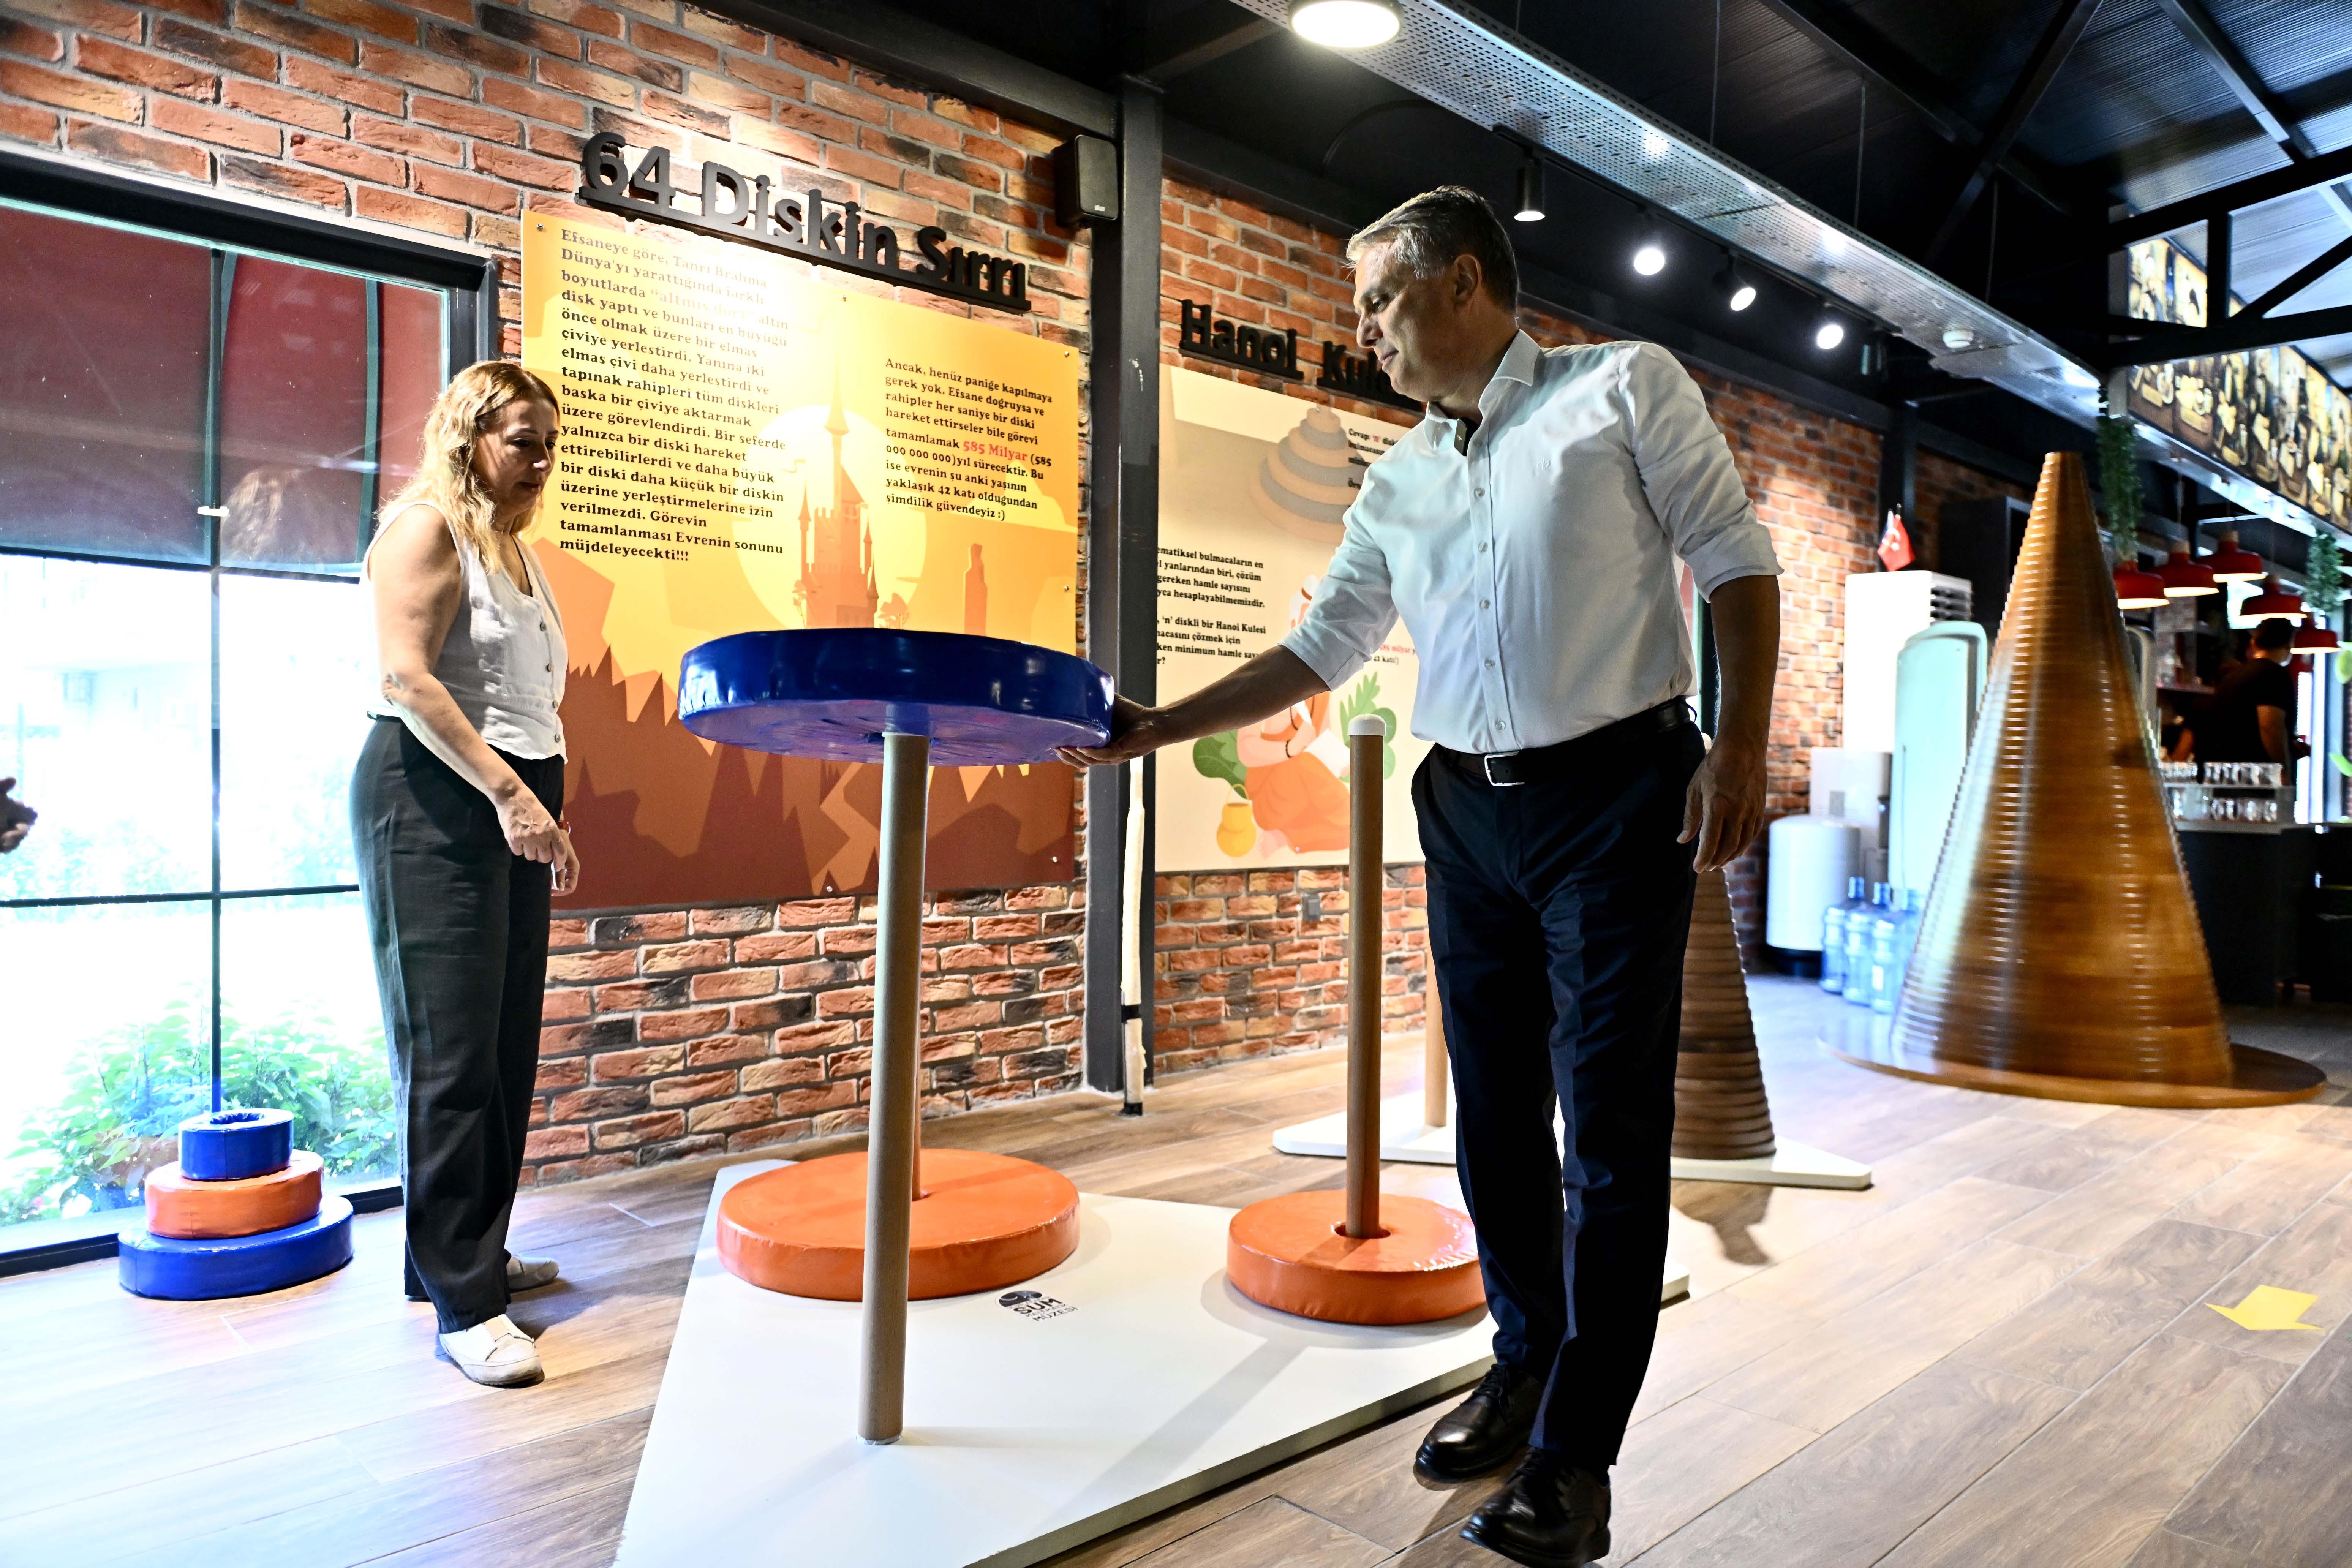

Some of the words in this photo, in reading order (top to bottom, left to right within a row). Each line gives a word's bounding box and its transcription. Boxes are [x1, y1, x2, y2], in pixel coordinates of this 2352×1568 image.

[583, 132, 675, 210] 64
[702, 161, 899, 267] Diskin
[917, 226, 1026, 301] Sırrı
[562, 229, 628, 254] Efsaneye
[633, 248, 668, 266] göre,
[562, 248, 628, 273] Dünya'yı
[561, 270, 645, 297] boyutlarda
[759, 316, 789, 330] altın
[562, 290, 595, 305] disk
[600, 300, 637, 314] yaptı
[643, 309, 658, 318] ve
[663, 311, 713, 330] bunları
[719, 326, 733, 334] en
[562, 308, 596, 324] önce
[602, 318, 647, 335] olmak
[653, 327, 691, 343] üzere
[696, 336, 715, 348] bir
[720, 343, 757, 357] elmas
[1181, 299, 1297, 373] Hanoi
[562, 329, 606, 345] çiviye
[697, 354, 741, 372] Yanına
[747, 365, 764, 376] iki
[562, 348, 605, 364] elmas
[610, 357, 636, 370] çivi
[642, 362, 675, 377] daha
[680, 371, 751, 391] yerleştirdi
[756, 386, 769, 395] ve
[886, 359, 925, 376] Ancak,
[930, 367, 962, 382] henüz
[966, 377, 999, 391] paniğe
[1002, 383, 1052, 403] kapılmaya
[562, 367, 621, 386] tapınak
[627, 380, 690, 398] rahipleri
[696, 390, 723, 404] tüm
[728, 397, 778, 414] diskleri
[886, 377, 917, 389] gerek
[922, 384, 945, 394] yok.
[949, 387, 983, 402] Efsane
[986, 396, 1031, 413] doğruysa
[562, 403, 603, 420] üzere
[608, 413, 709, 437] görevlendirdi.
[715, 429, 735, 441] Bir
[740, 436, 785, 449] seferde
[611, 394, 632, 406] bir
[637, 399, 678, 414] çiviye
[684, 408, 751, 427] aktarmak
[886, 393, 933, 407] rahipler
[936, 401, 954, 412] her
[958, 407, 990, 420] saniye
[993, 412, 1007, 423] bir
[1011, 417, 1034, 429] diski
[886, 407, 930, 424] hareket
[934, 418, 983, 433] ettirseler
[987, 427, 1005, 438] bile
[1008, 432, 1038, 445] görevi
[561, 426, 623, 442] yalnızca
[628, 433, 649, 446] bir
[654, 438, 689, 452] diski
[694, 444, 746, 461] hareket
[886, 428, 959, 448] tamamlamak
[963, 441, 985, 454] 585
[989, 444, 1027, 461] Milyar
[1031, 454, 1051, 466] (585
[561, 444, 671, 468] ettirebilirlerdi
[677, 462, 691, 470] ve
[696, 463, 727, 476] daha
[733, 468, 775, 483] büyük
[886, 445, 905, 455] 000
[910, 449, 928, 458] 000
[933, 453, 970, 466] 000)yıl
[974, 459, 1027, 476] sürecektir.
[1031, 469, 1043, 479] Bu
[886, 460, 901, 470] ise
[905, 466, 947, 478] evrenin
[950, 473, 961, 481] şu
[965, 475, 988, 485] anki
[991, 480, 1026, 492] yaşının
[561, 462, 583, 474] bir
[588, 466, 626, 480] diski
[631, 472, 665, 485] daha
[670, 477, 714, 492] küçük
[719, 484, 738, 495] bir
[743, 488, 783, 501] diskin
[561, 480, 618, 497] üzerine
[623, 492, 745, 514] yerleştirmelerine
[749, 505, 773, 517] izin
[886, 479, 934, 492] yaklaşık
[938, 486, 950, 495] 42
[954, 487, 975, 498] katı
[978, 492, 1037, 509] olduğundan
[560, 503, 645, 519] verilmezdi.
[650, 511, 706, 527] Görevin
[887, 495, 933, 508] şimdilik
[937, 501, 995, 517] güvendeyiz
[998, 510, 1005, 521] :)
[560, 520, 671, 541] tamamlanması
[676, 532, 730, 547] Evrenin
[735, 542, 782, 553] sonunu
[560, 539, 688, 561] müjdeleyecekti!!!
[1157, 547, 1197, 559] ematiksel
[1200, 552, 1252, 567] bulmacaların
[1164, 562, 1215, 575] yanlarından
[1217, 568, 1234, 579] biri,
[1236, 571, 1261, 581] çözüm
[1174, 589, 1265, 607] hesaplayabilmemizdir.
[1193, 578, 1218, 588] hamle
[1220, 583, 1250, 593] sayısını
[1157, 631, 1189, 639] acasını
[1192, 632, 1223, 643] çözmek
[1226, 635, 1240, 645] için
[1175, 617, 1199, 627] diskli
[1201, 620, 1214, 628] bir
[1216, 621, 1239, 631] Hanoi
[1242, 623, 1266, 634] Kulesi
[1175, 645, 1216, 655] minimum
[1218, 648, 1242, 658] hamle
